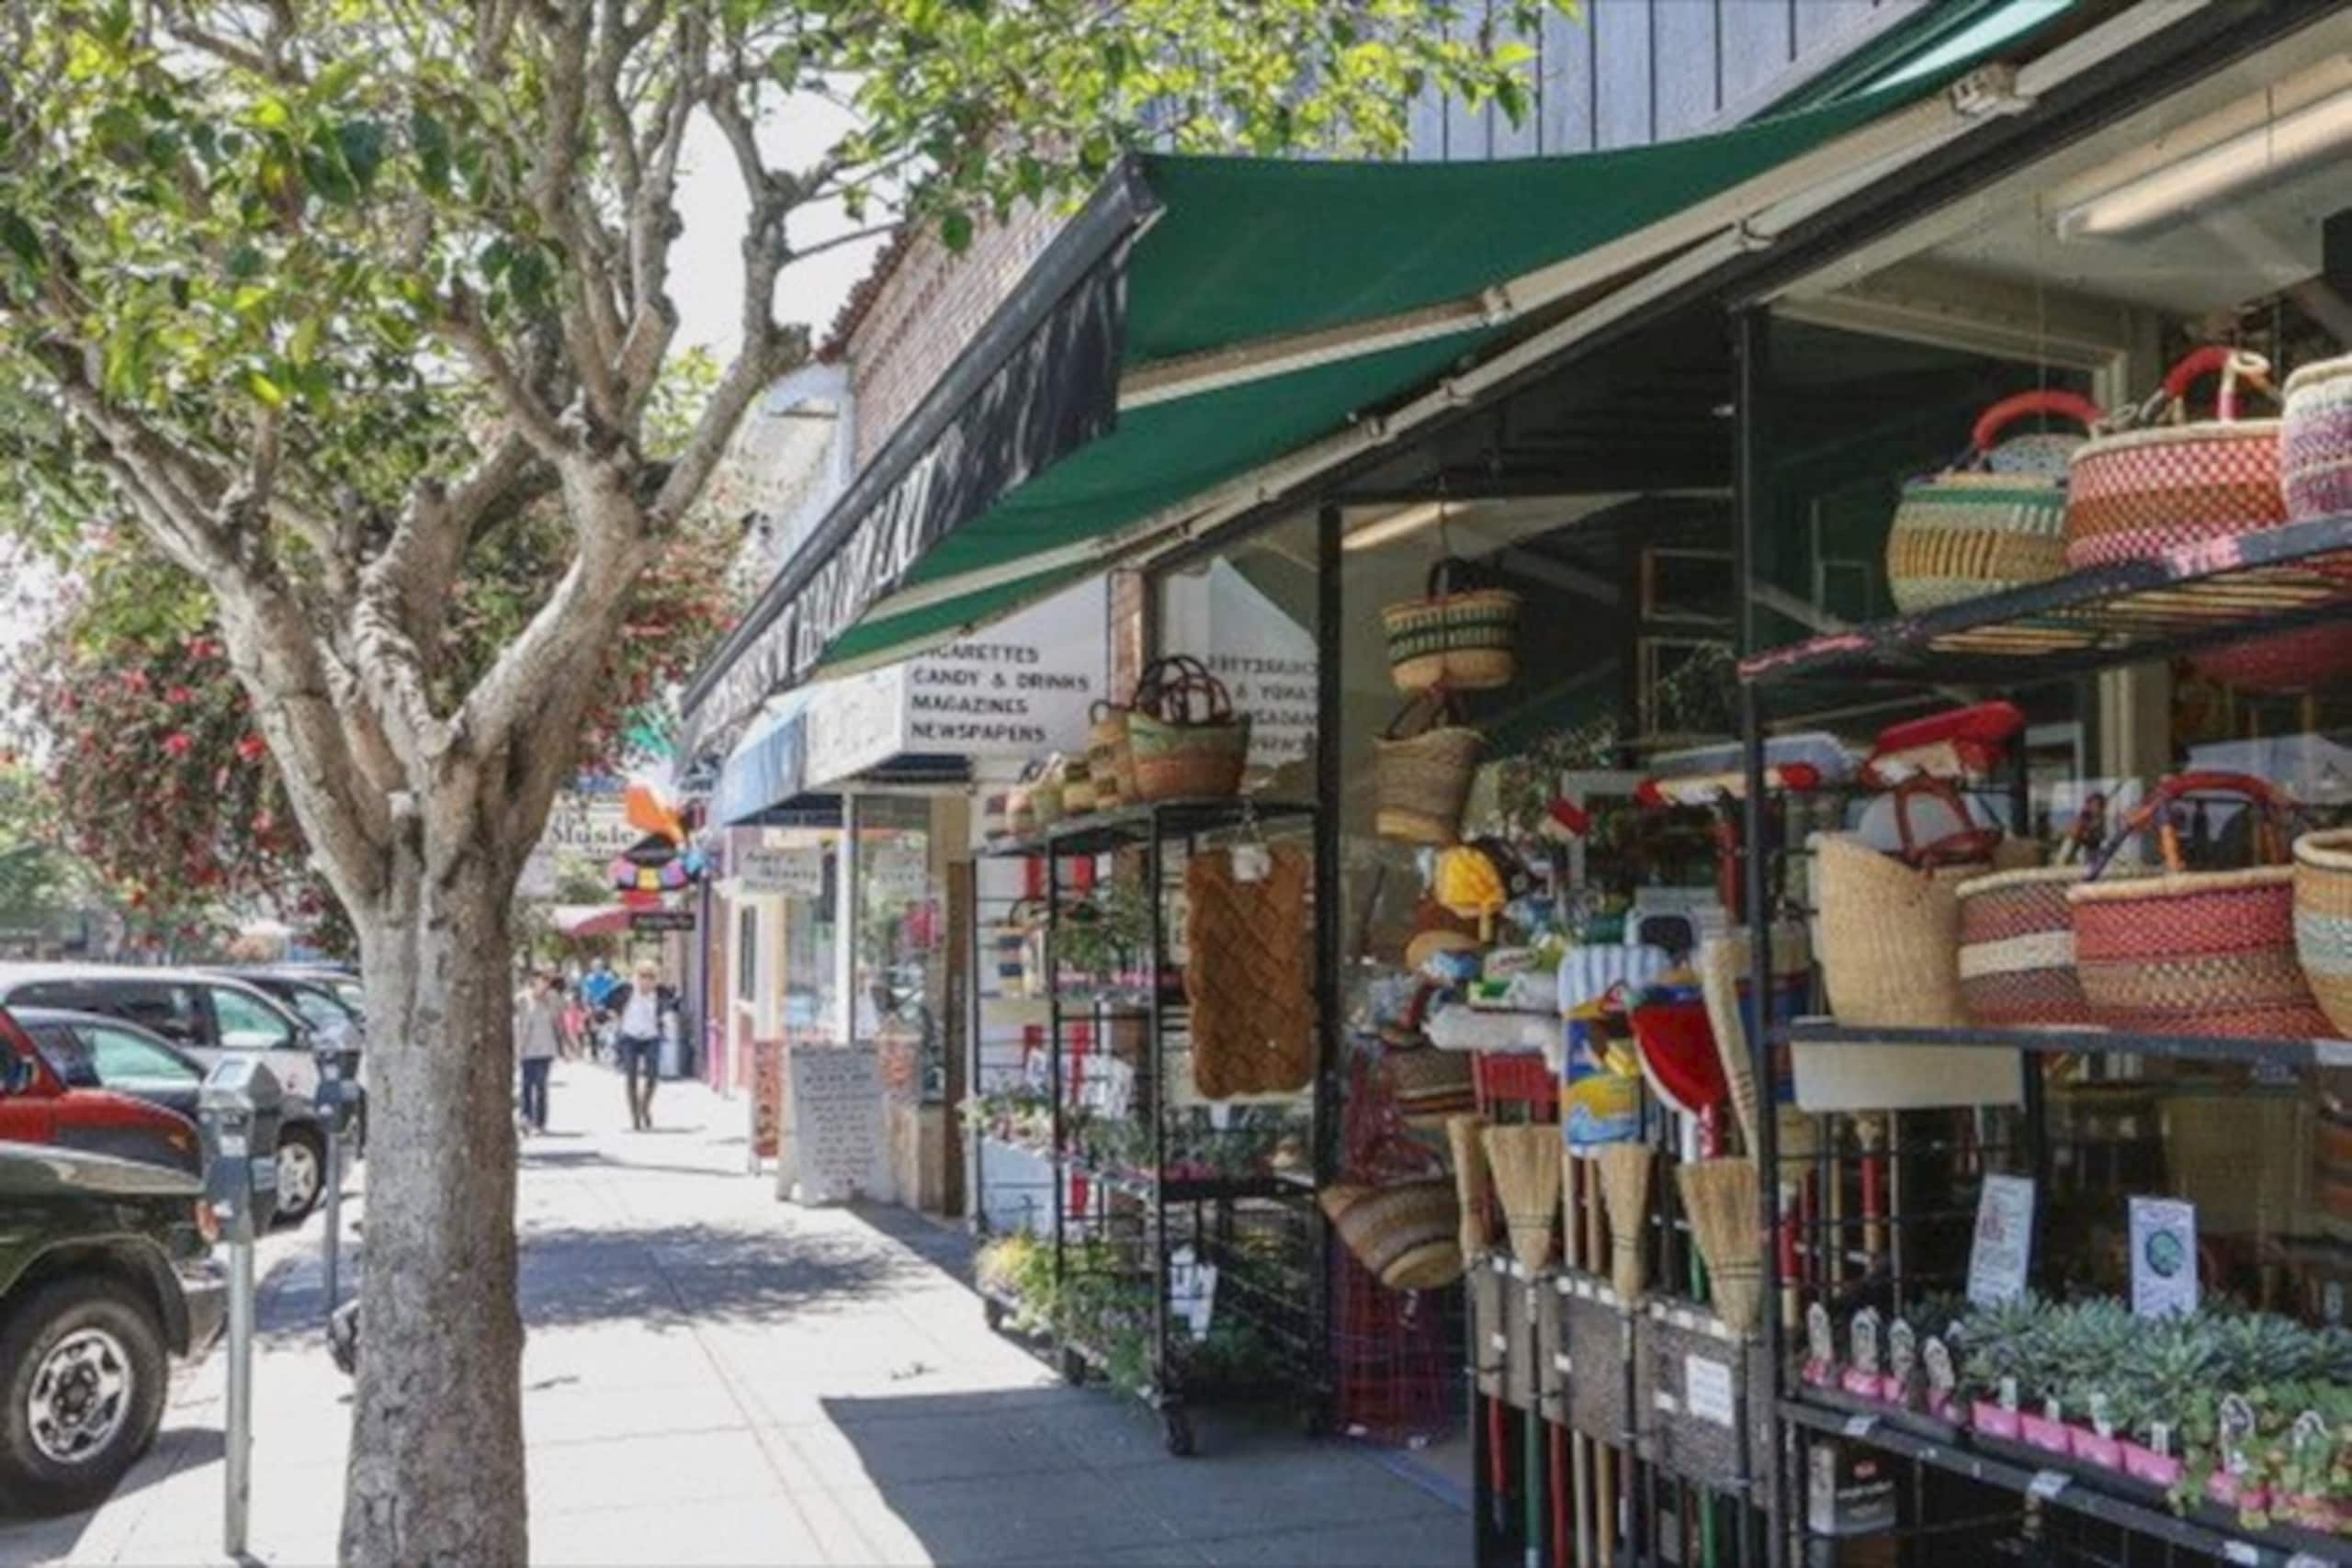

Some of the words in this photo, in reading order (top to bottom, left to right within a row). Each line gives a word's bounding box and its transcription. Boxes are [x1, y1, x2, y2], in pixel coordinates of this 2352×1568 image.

[916, 643, 1039, 663] IGARETTES
[912, 667, 979, 686] CANDY
[991, 671, 1007, 688] &
[1016, 672, 1090, 691] DRINKS
[911, 694, 1029, 714] MAGAZINES
[910, 721, 1046, 742] NEWSPAPERS
